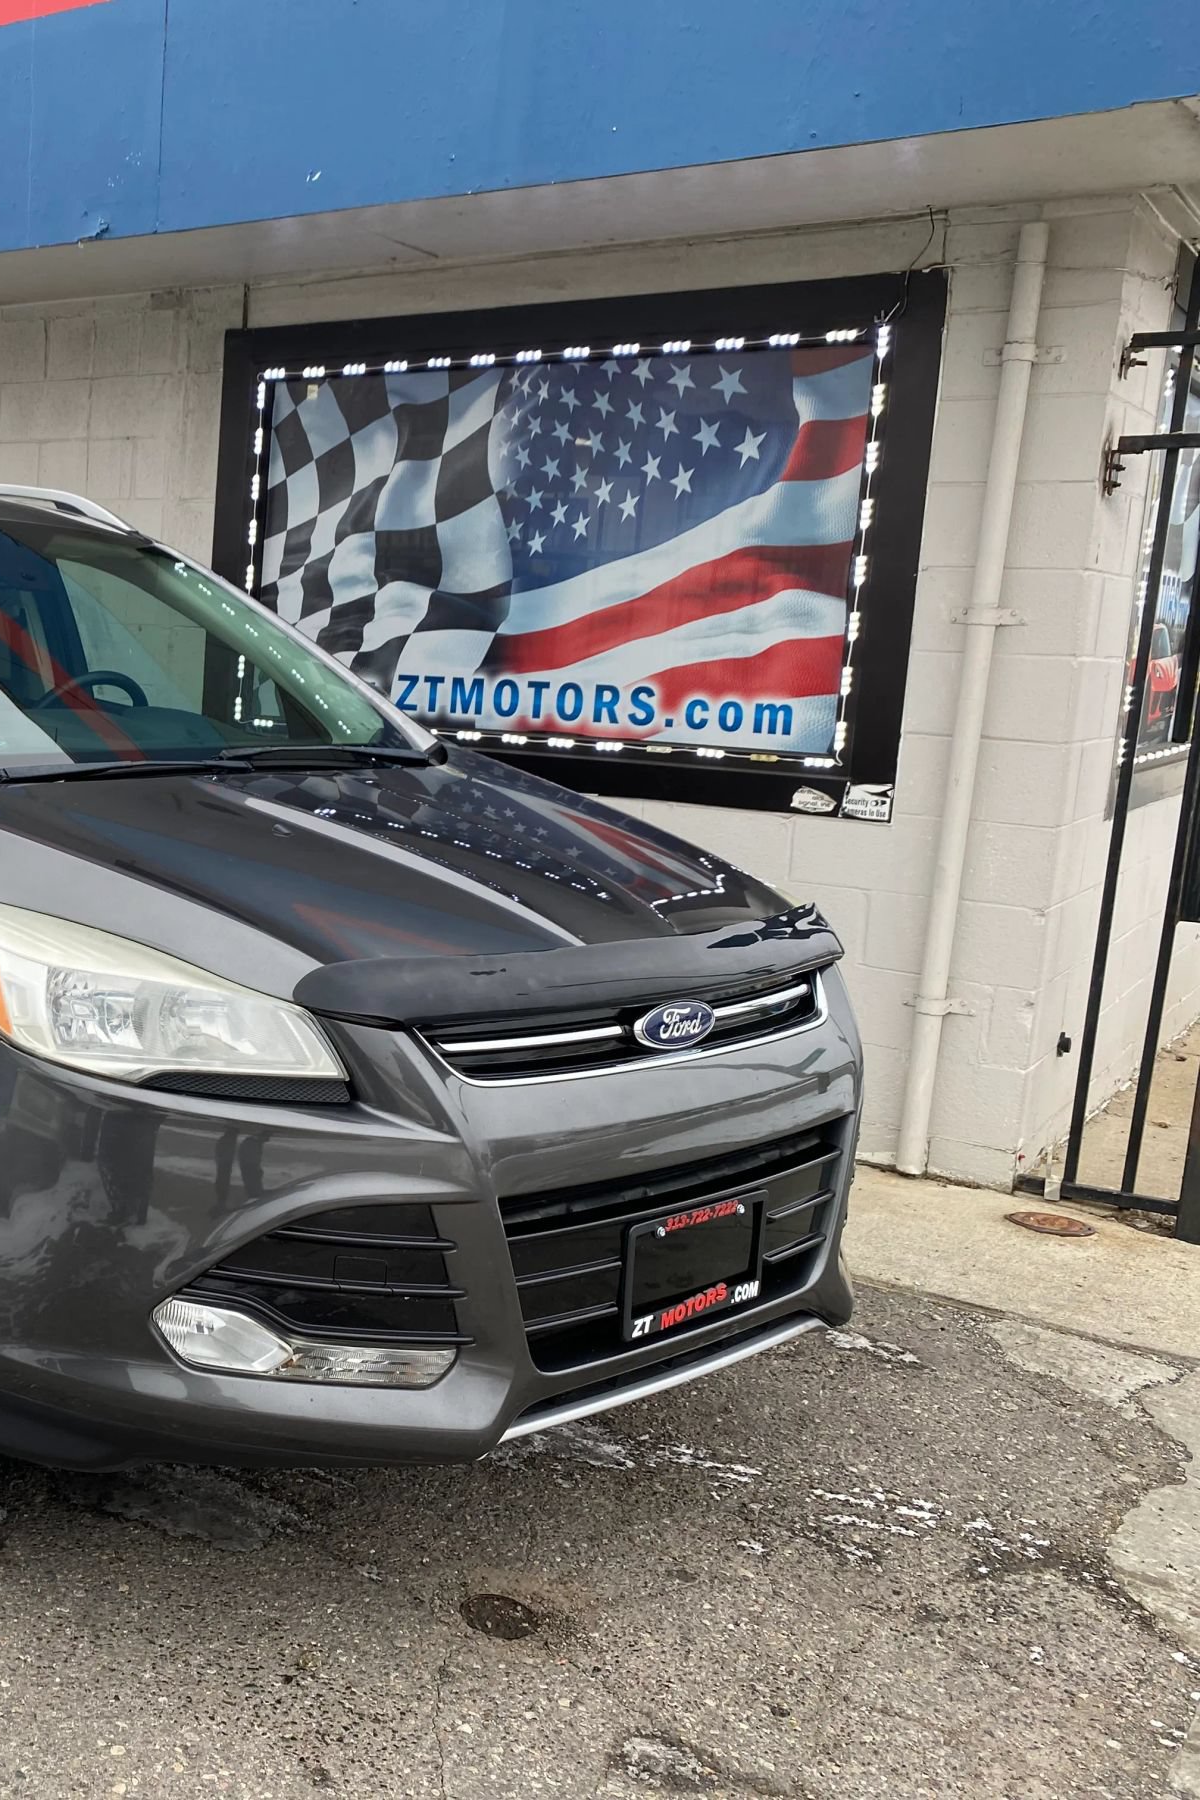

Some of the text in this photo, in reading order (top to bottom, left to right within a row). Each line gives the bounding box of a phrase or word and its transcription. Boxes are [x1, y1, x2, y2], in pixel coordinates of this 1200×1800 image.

[395, 674, 793, 736] ZTMOTORS.com
[660, 1007, 702, 1039] Ford
[665, 1199, 738, 1231] 313-722-7222
[631, 1281, 760, 1338] ZT MOTORS .COM
